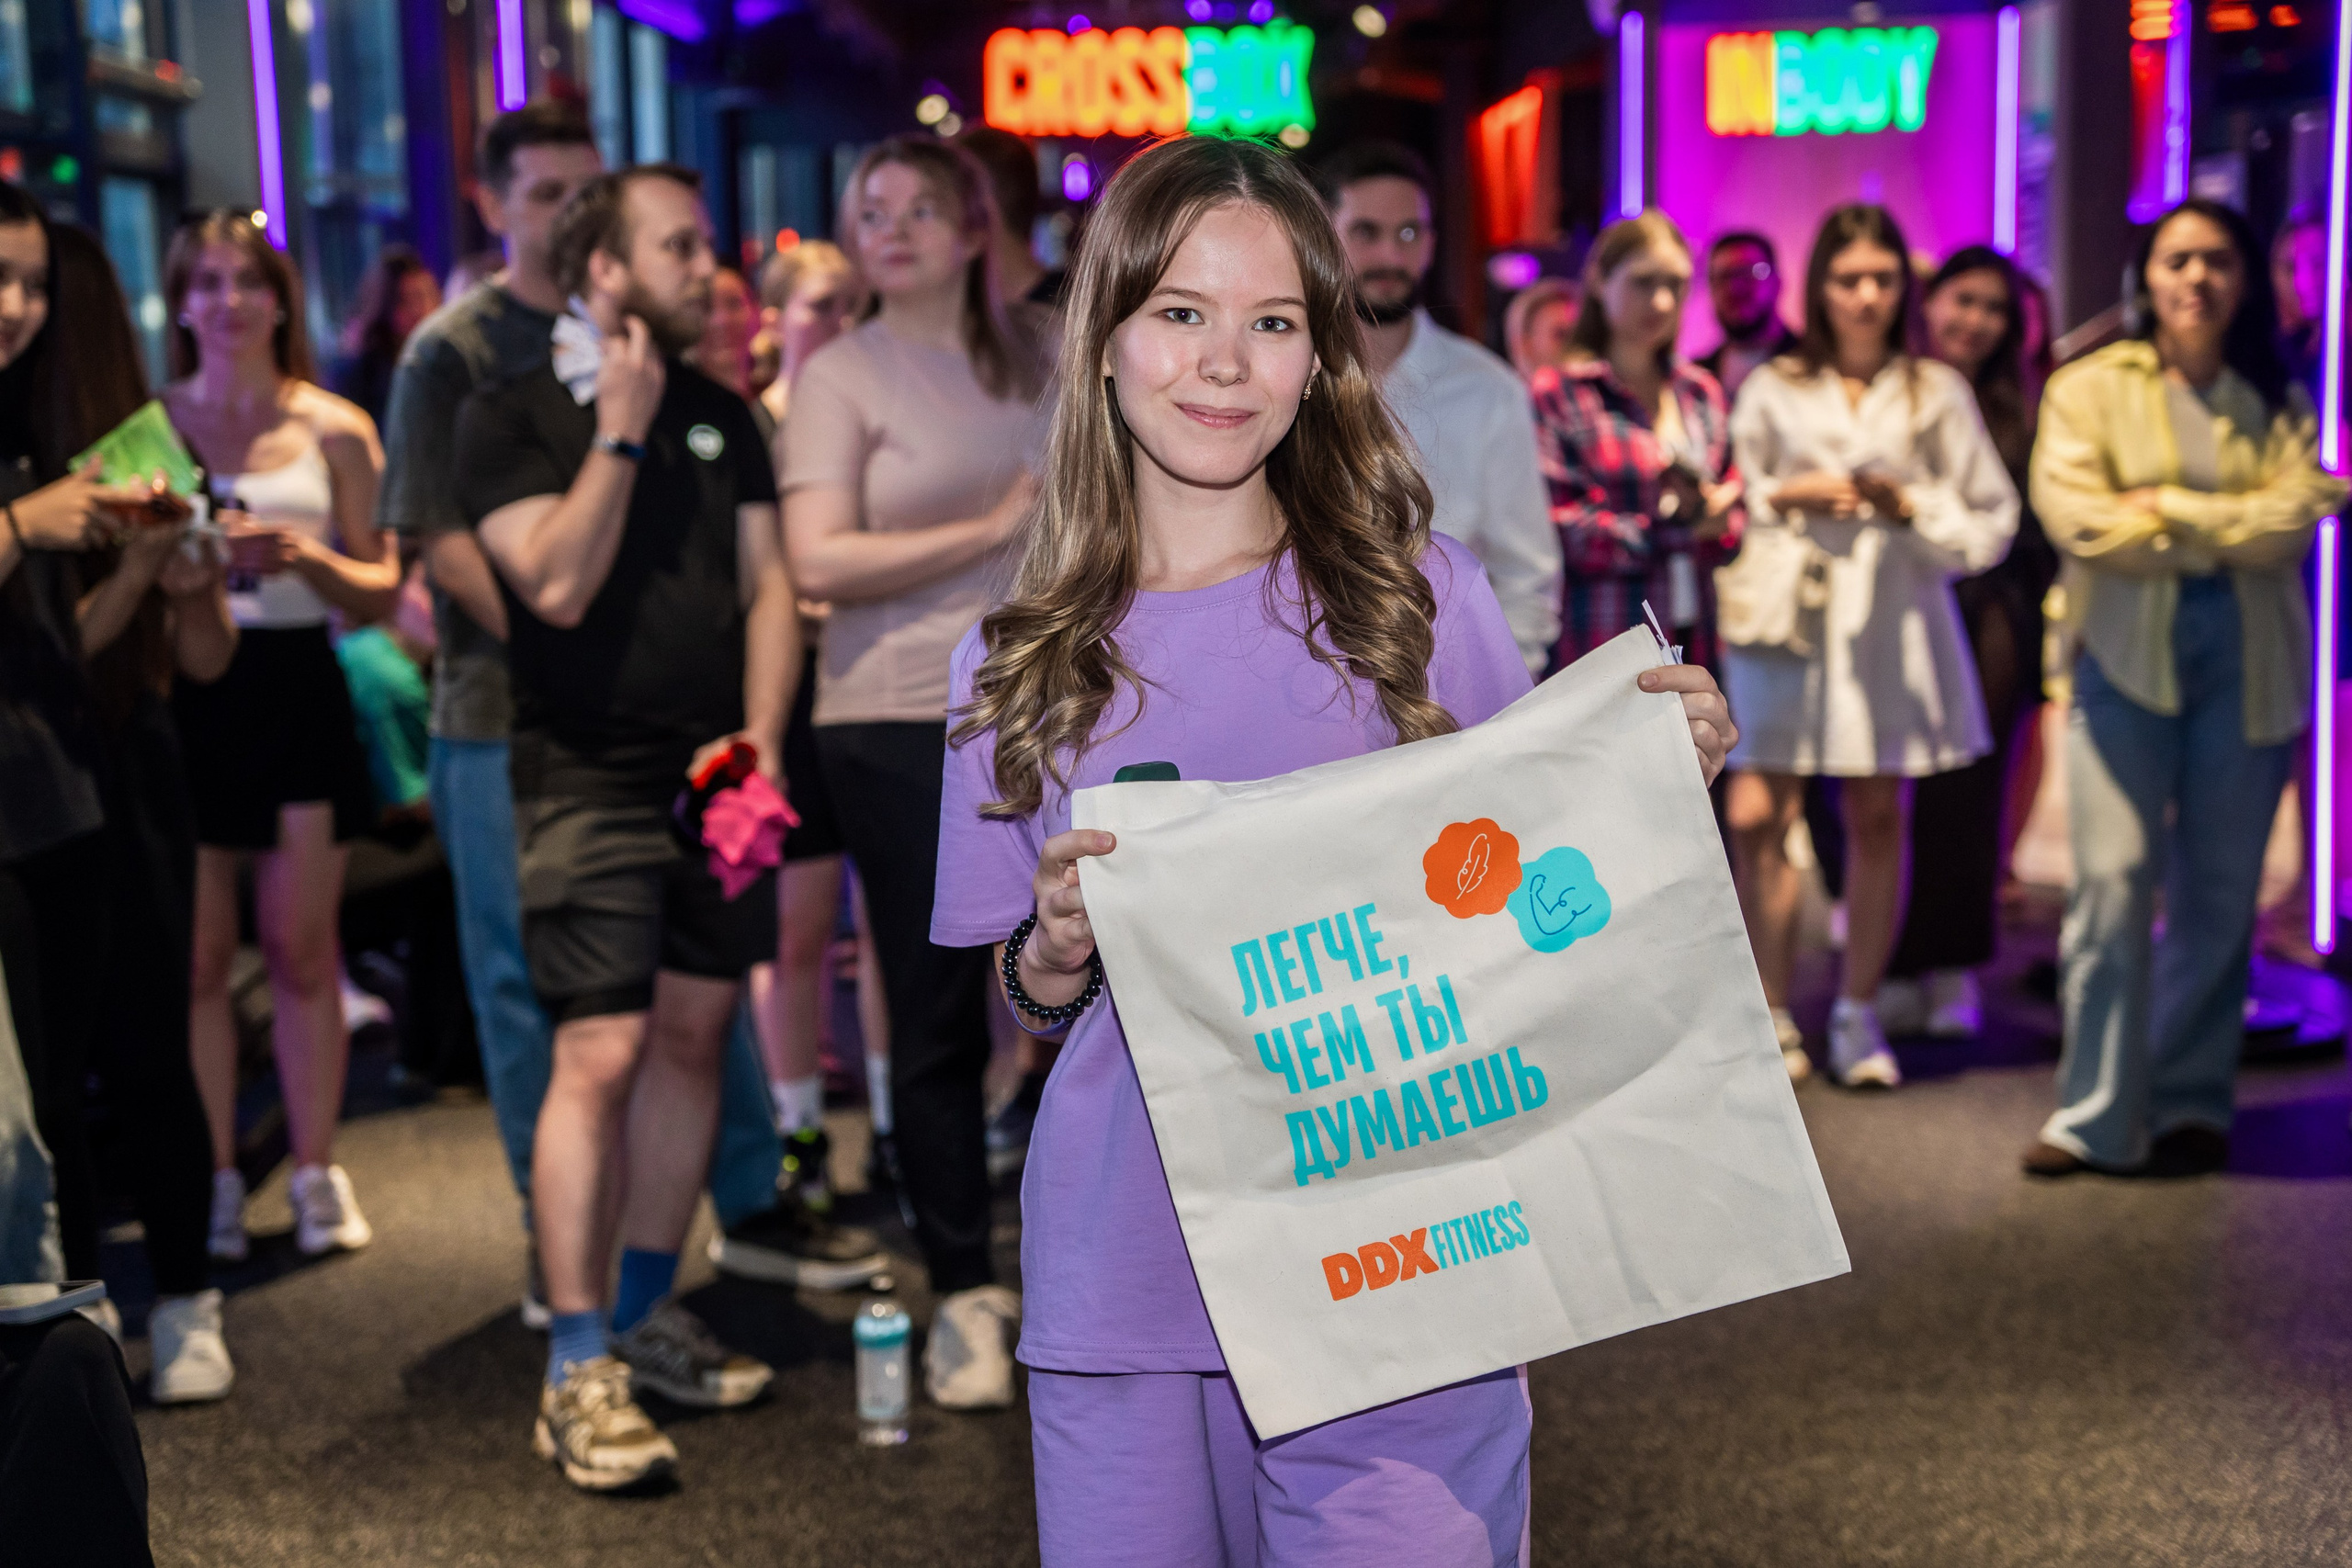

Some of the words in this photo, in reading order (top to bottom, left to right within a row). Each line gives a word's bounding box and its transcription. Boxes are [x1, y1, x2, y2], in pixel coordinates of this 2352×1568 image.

[1705, 27, 1939, 136] INBODY
[1230, 902, 1410, 1017] ЛЕГЧЕ,
[1254, 1004, 1375, 1095] ЧЕМ
[1375, 974, 1469, 1061] ТЫ
[1284, 1045, 1549, 1187] ДУМАЕШЬ
